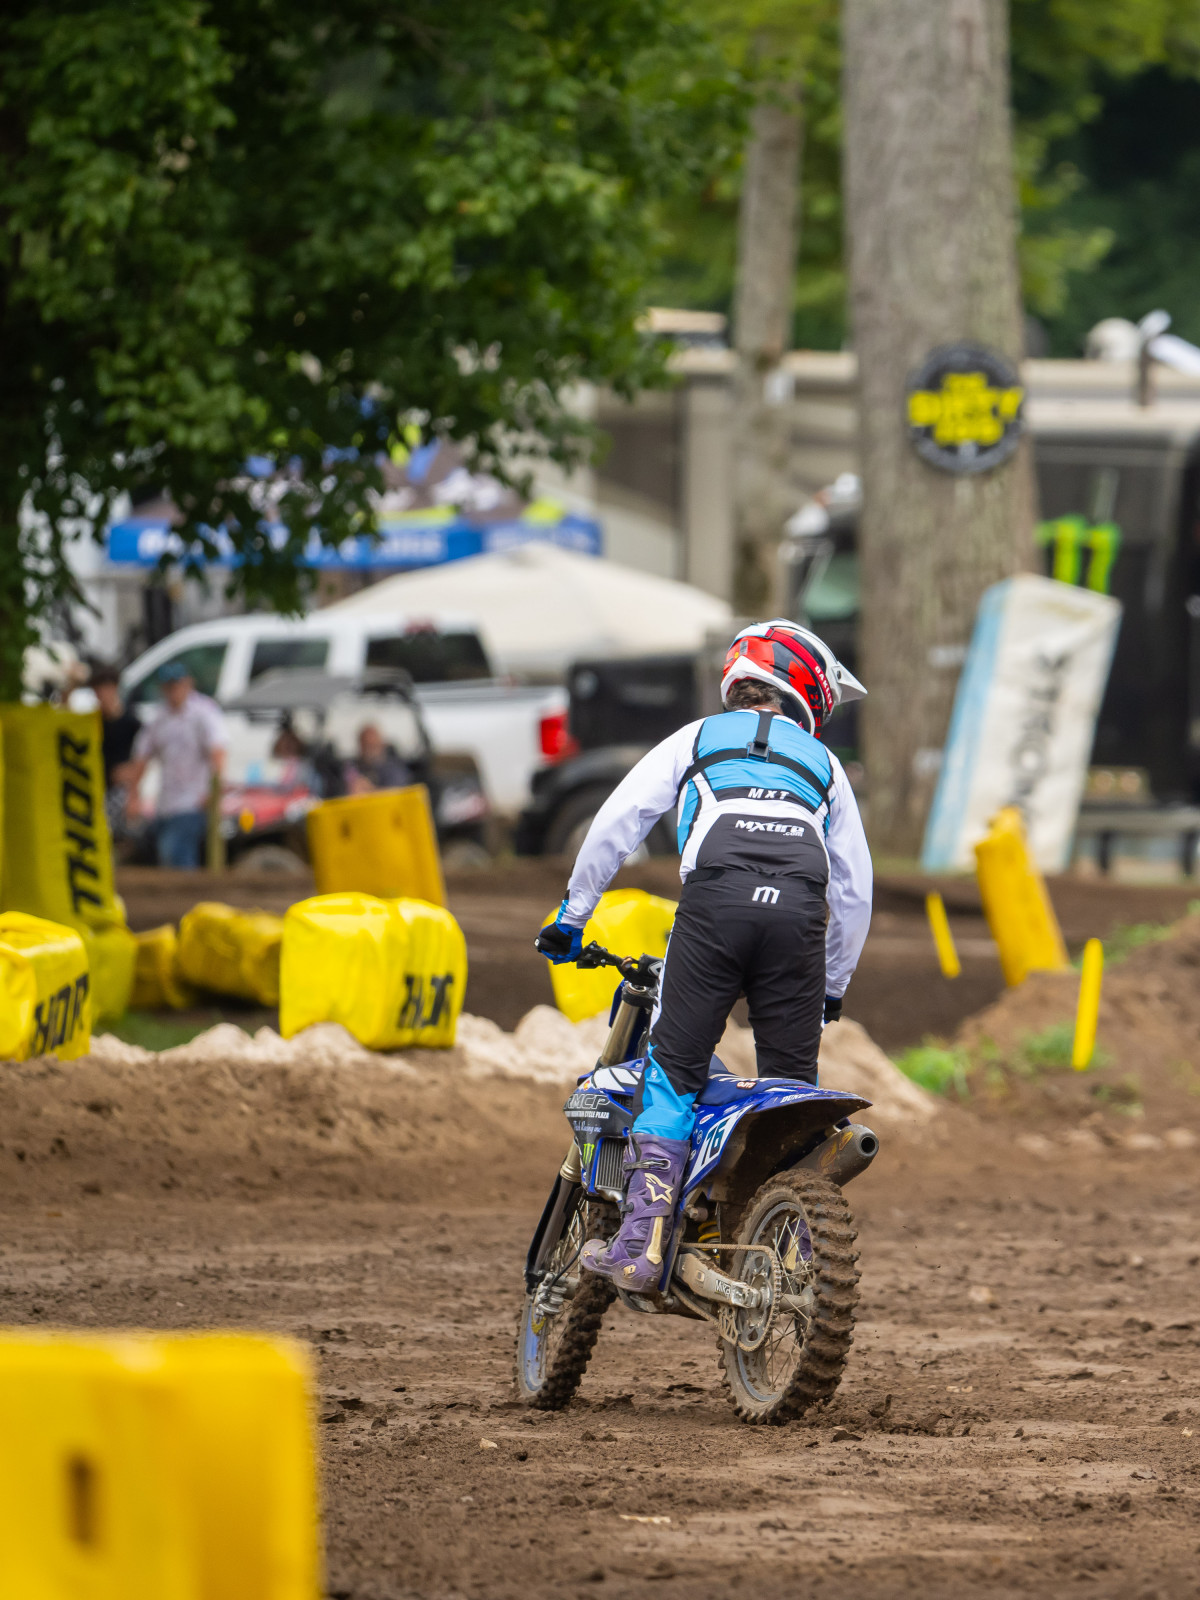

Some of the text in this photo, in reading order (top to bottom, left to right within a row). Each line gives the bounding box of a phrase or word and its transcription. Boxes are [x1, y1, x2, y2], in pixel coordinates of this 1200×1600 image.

[814, 665, 833, 705] OAKLEY
[747, 787, 790, 800] MXT
[57, 730, 103, 914] THOR
